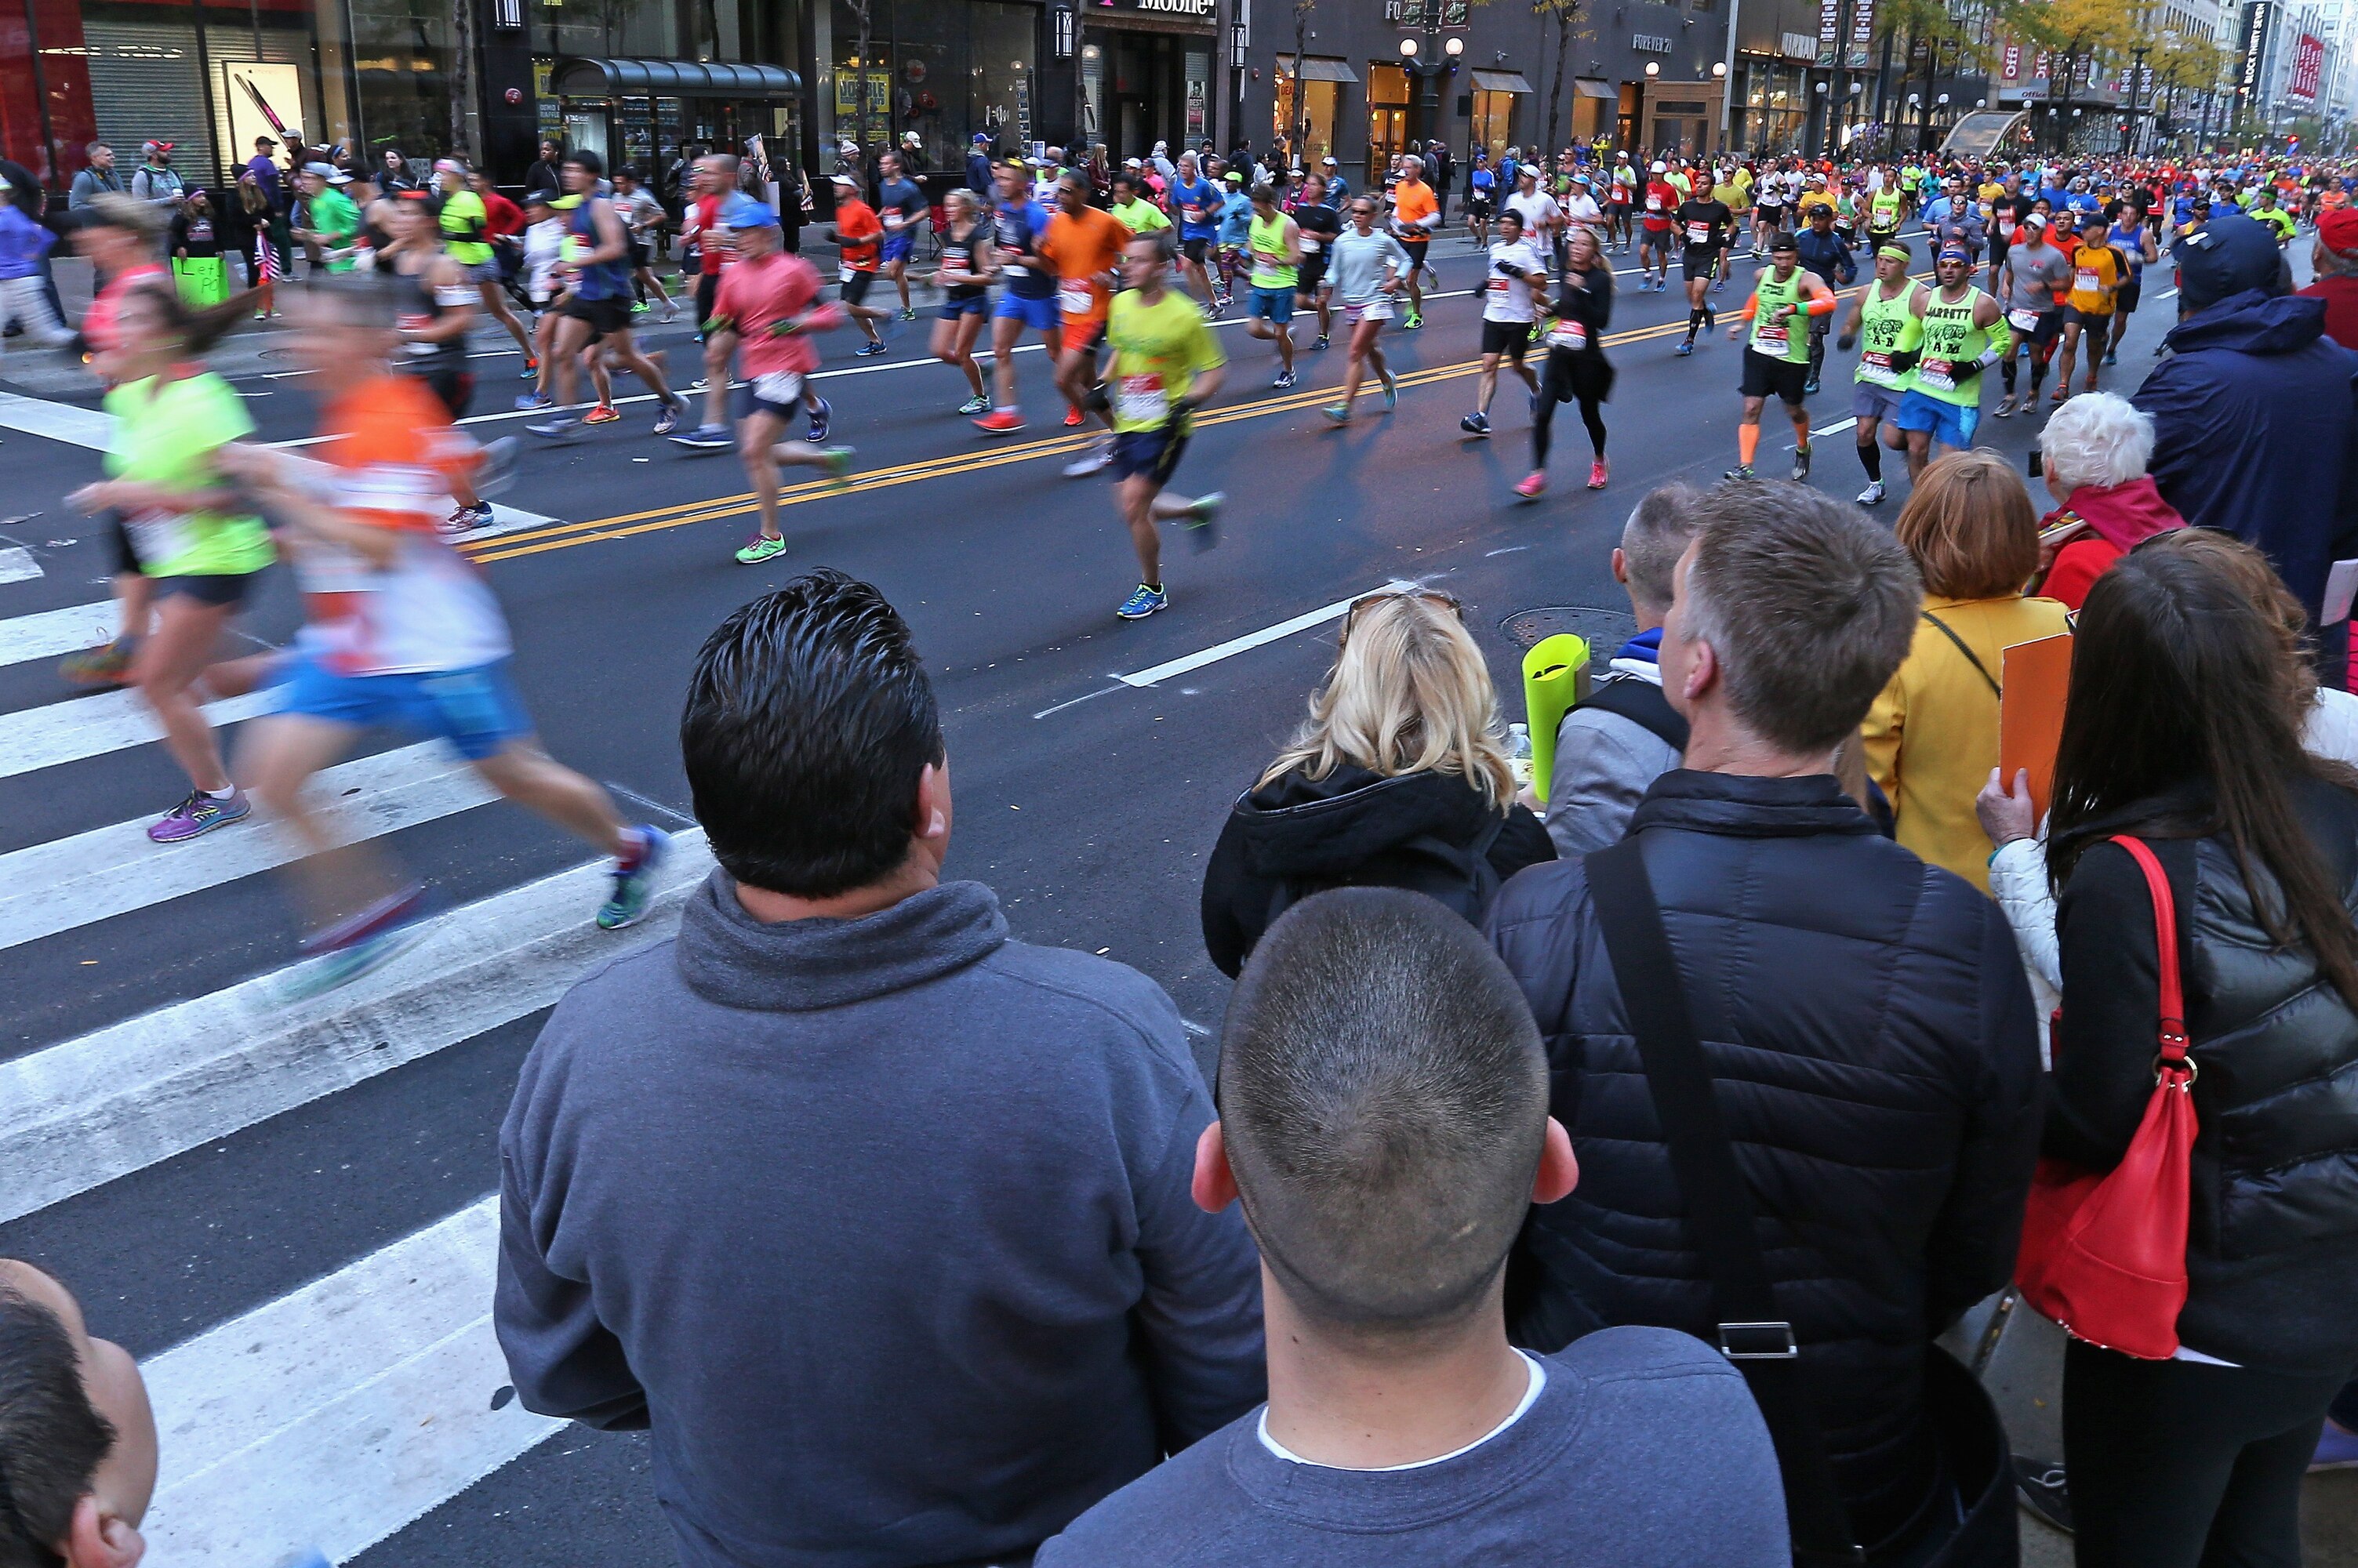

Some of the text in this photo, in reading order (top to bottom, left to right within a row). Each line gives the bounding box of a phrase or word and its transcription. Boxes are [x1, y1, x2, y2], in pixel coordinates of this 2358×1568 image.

[2253, 3, 2265, 30] SEVEN
[1633, 34, 1663, 52] FOREVER
[1781, 32, 1817, 60] URBAN
[2247, 30, 2261, 56] THIRTY
[2244, 56, 2257, 84] BLOCK
[1926, 307, 1971, 321] JARRETT
